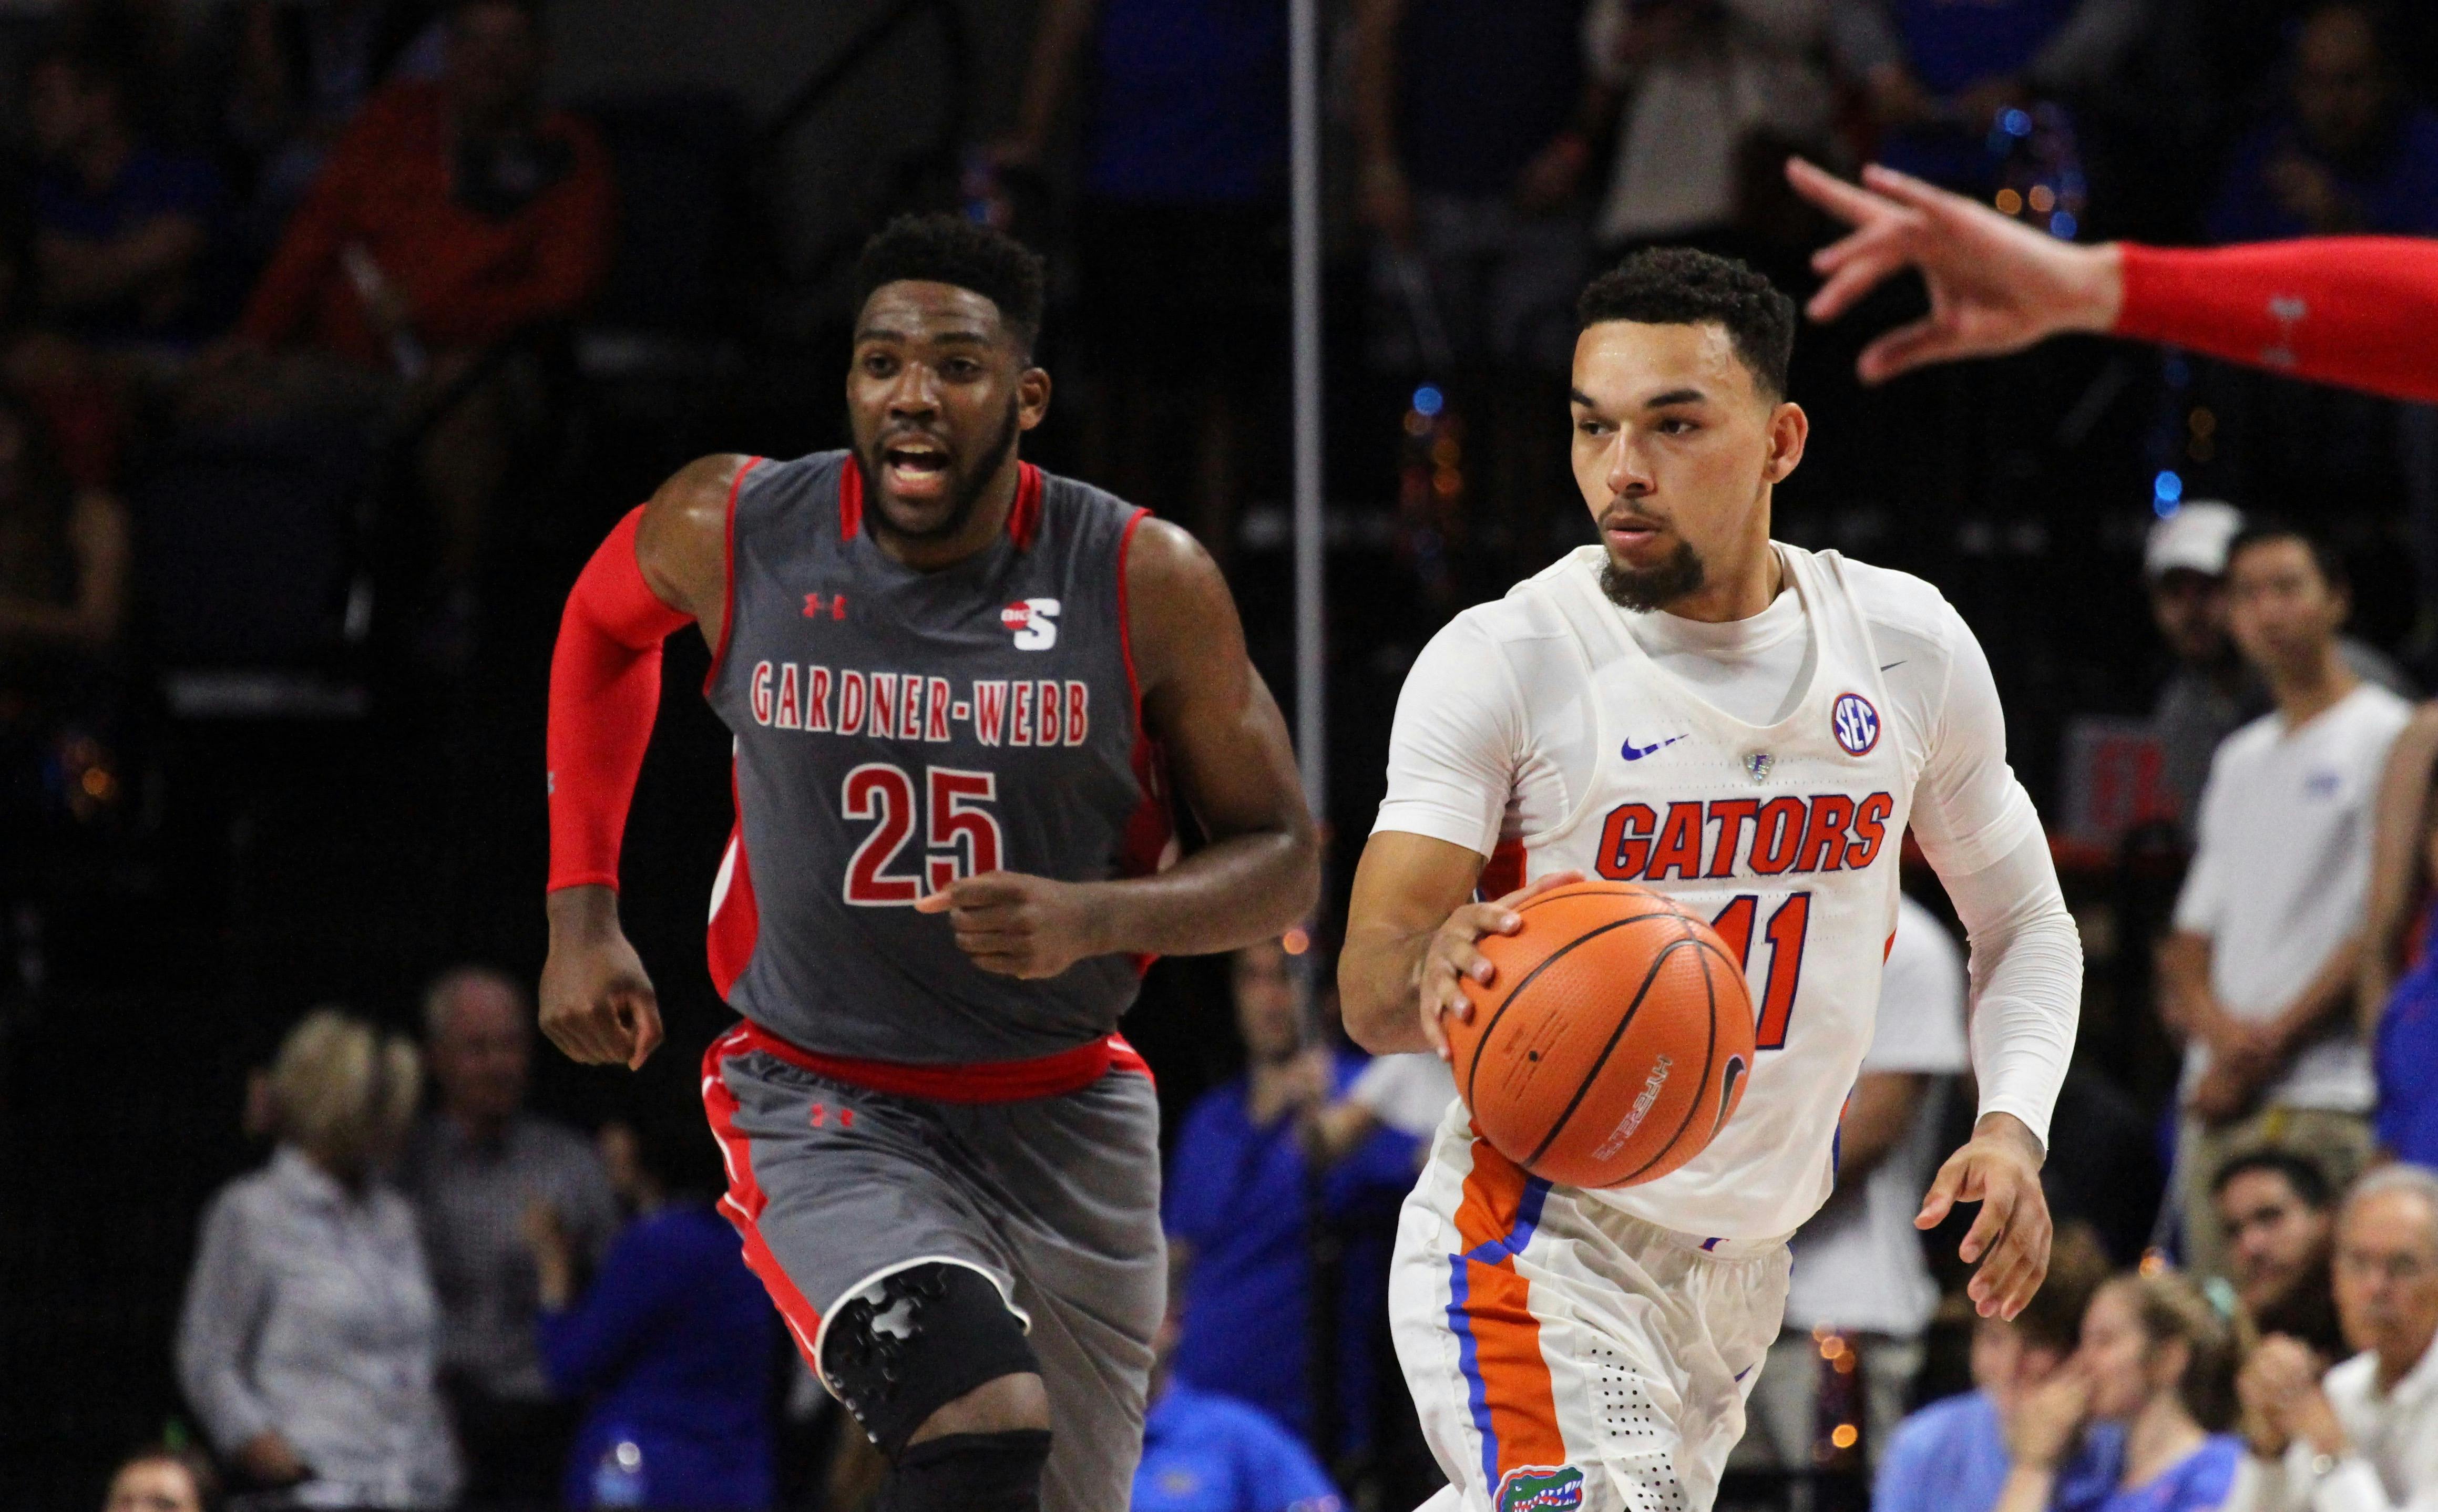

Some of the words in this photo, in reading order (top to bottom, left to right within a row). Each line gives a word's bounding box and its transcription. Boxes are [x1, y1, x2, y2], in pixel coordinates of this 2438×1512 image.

[750, 661, 1089, 747] GARDNER-WEBB
[1836, 698, 1876, 750] SEC
[843, 763, 1002, 907] 25
[1595, 791, 1893, 881] GATORS
[1591, 1054, 1674, 1161] HYPERELE
